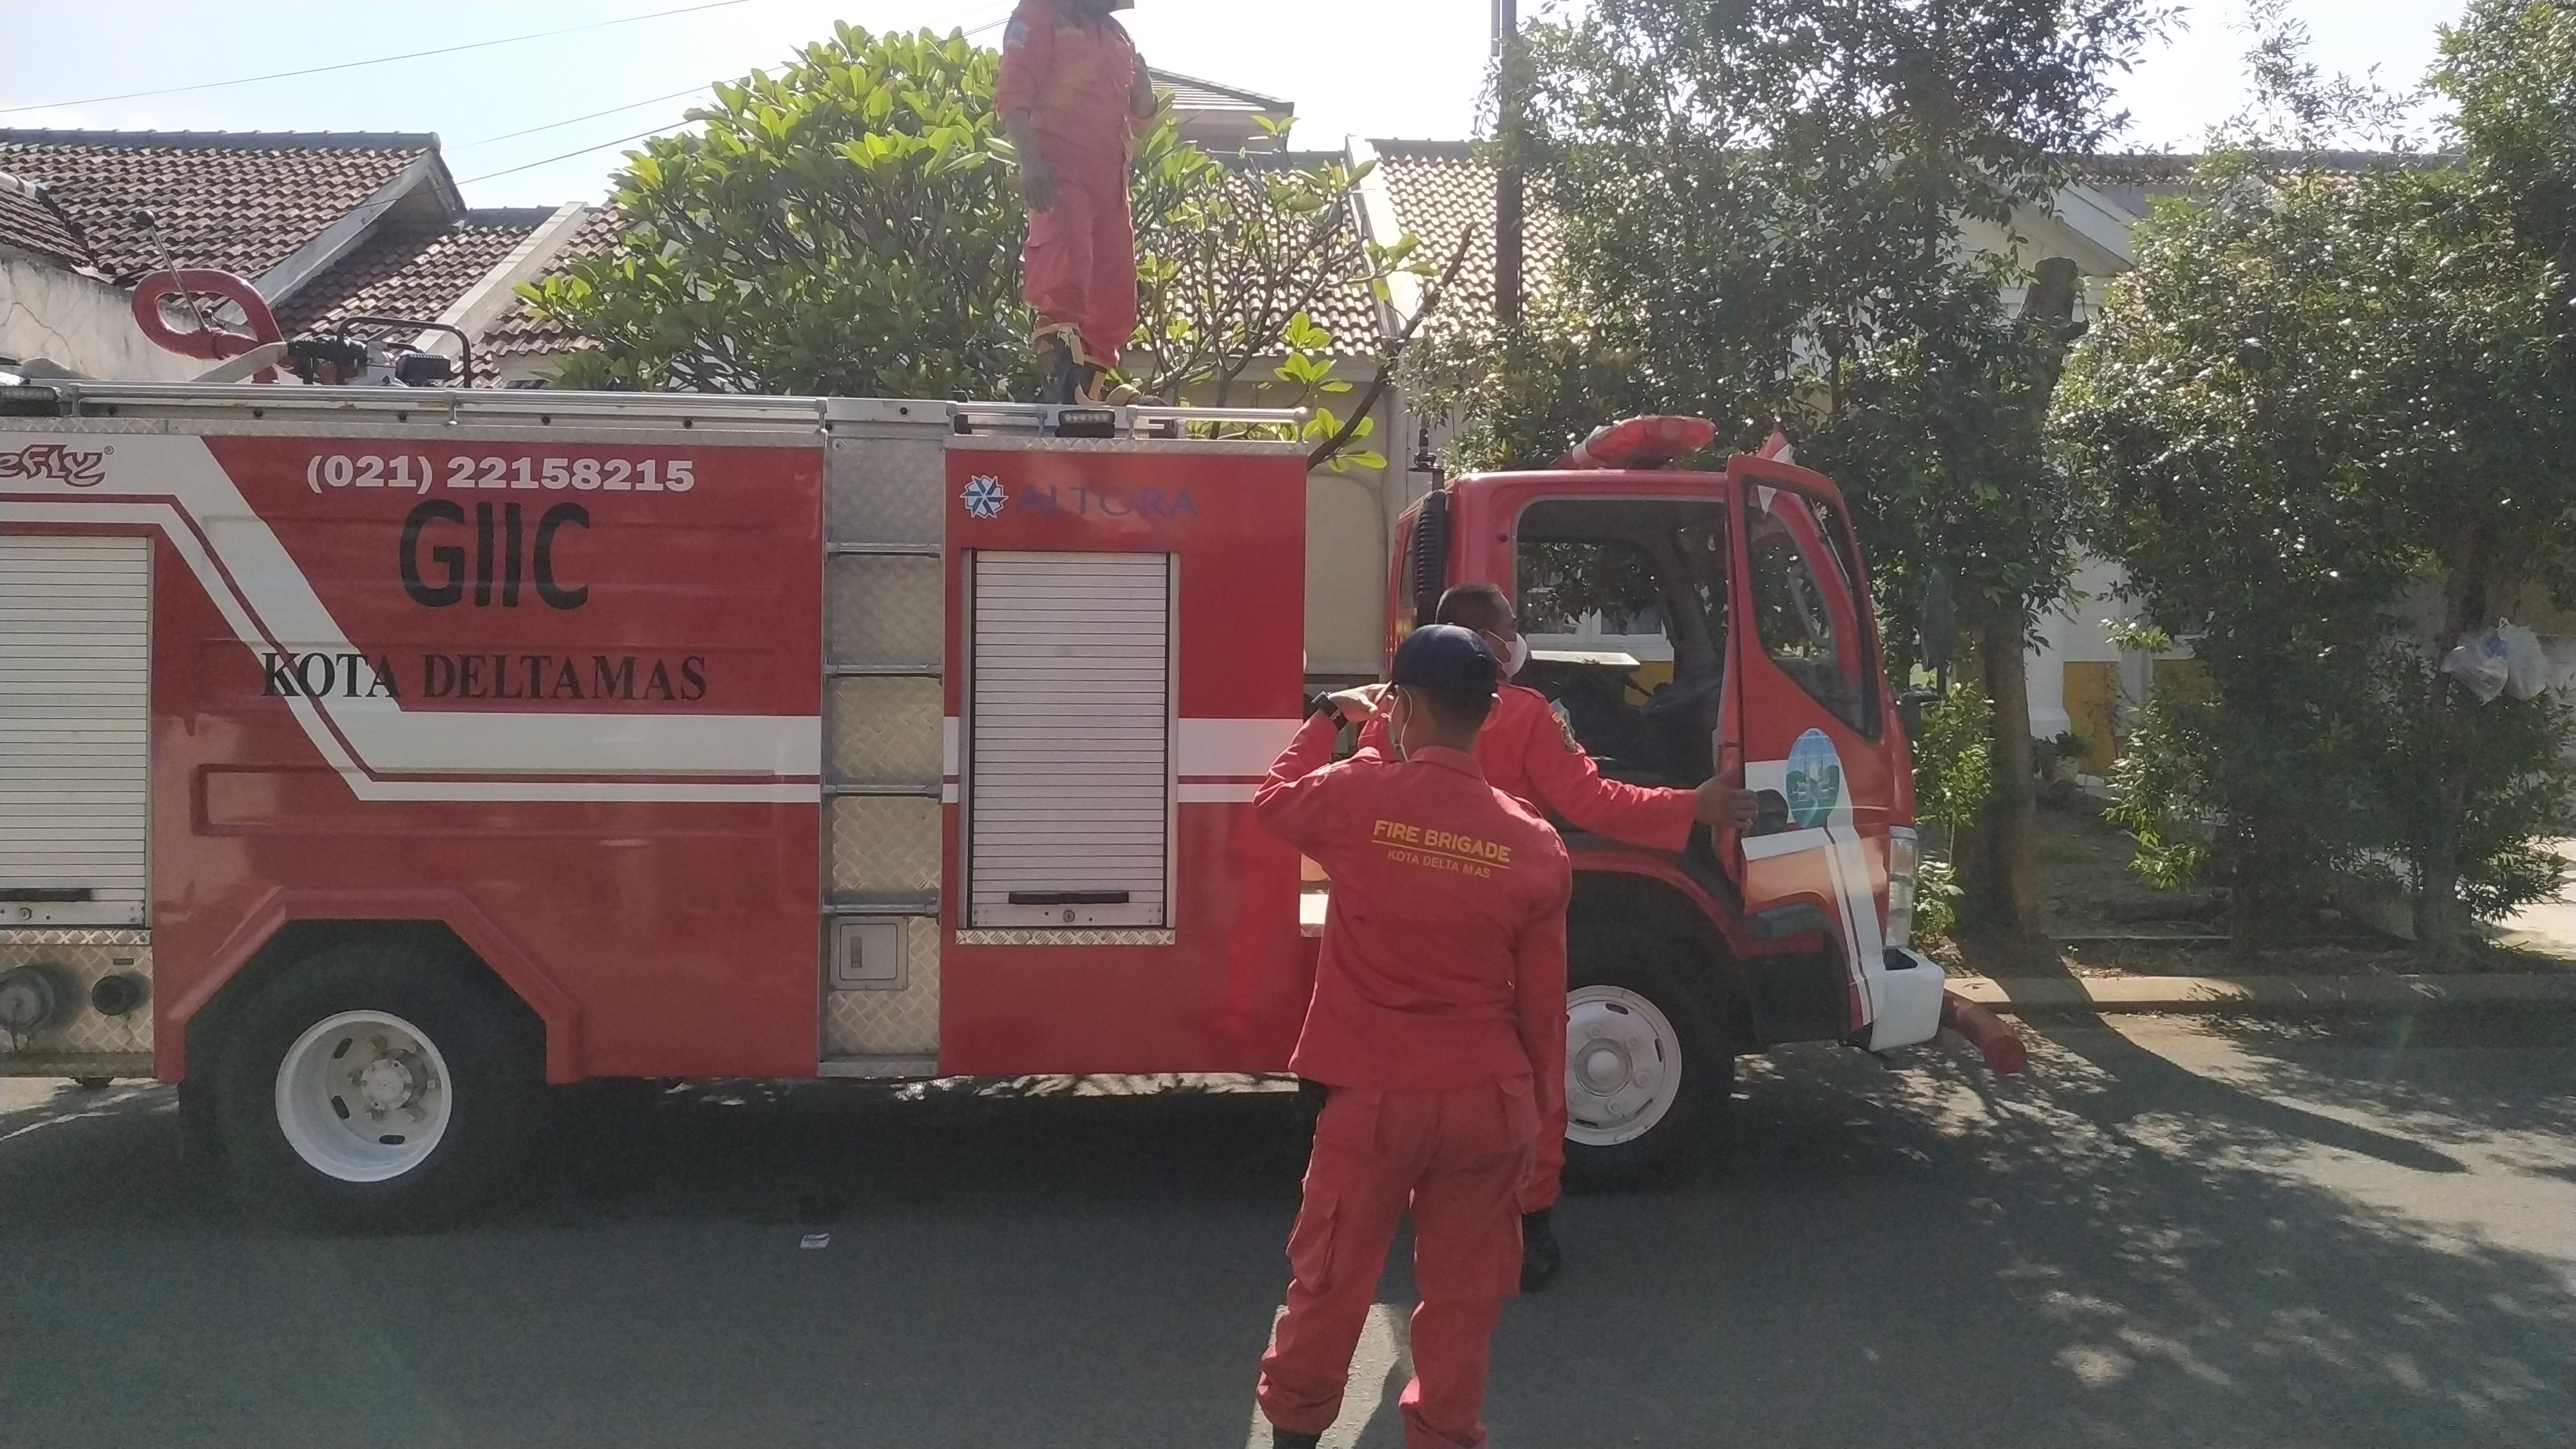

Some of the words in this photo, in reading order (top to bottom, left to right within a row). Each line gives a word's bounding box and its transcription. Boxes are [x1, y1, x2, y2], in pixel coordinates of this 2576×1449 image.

[307, 455, 433, 494] (021)
[447, 456, 695, 492] 22158215
[1015, 482, 1199, 519] ALTORA
[399, 498, 590, 609] GIIC
[260, 652, 401, 699] KOTA
[421, 653, 706, 701] DELTAMAS
[1373, 819, 1421, 843] FIRE
[1423, 828, 1511, 863] BRIGADE
[1387, 849, 1419, 865] KOTA
[1422, 855, 1459, 872] DELTA
[1462, 864, 1491, 878] MAS
